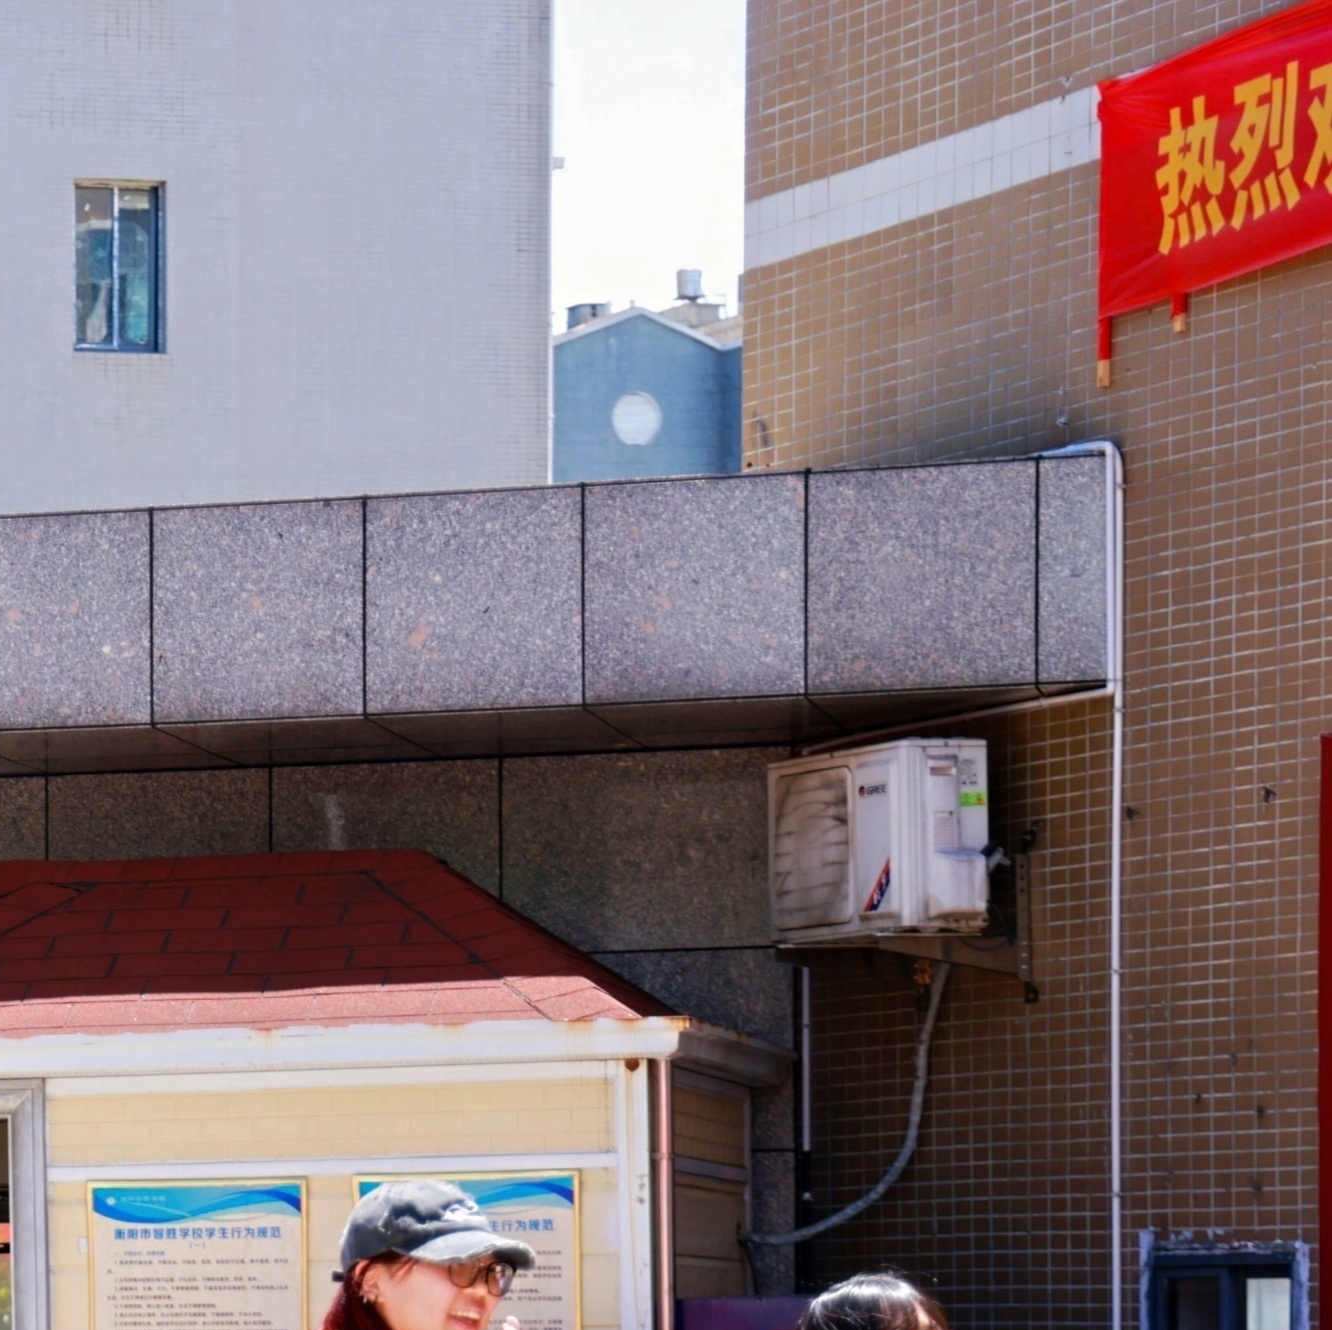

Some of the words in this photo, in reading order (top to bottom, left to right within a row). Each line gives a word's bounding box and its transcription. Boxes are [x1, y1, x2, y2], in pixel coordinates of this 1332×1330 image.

[866, 784, 887, 796] GREE
[114, 1226, 282, 1240] 衡阳市智胜学校学生行为规范
